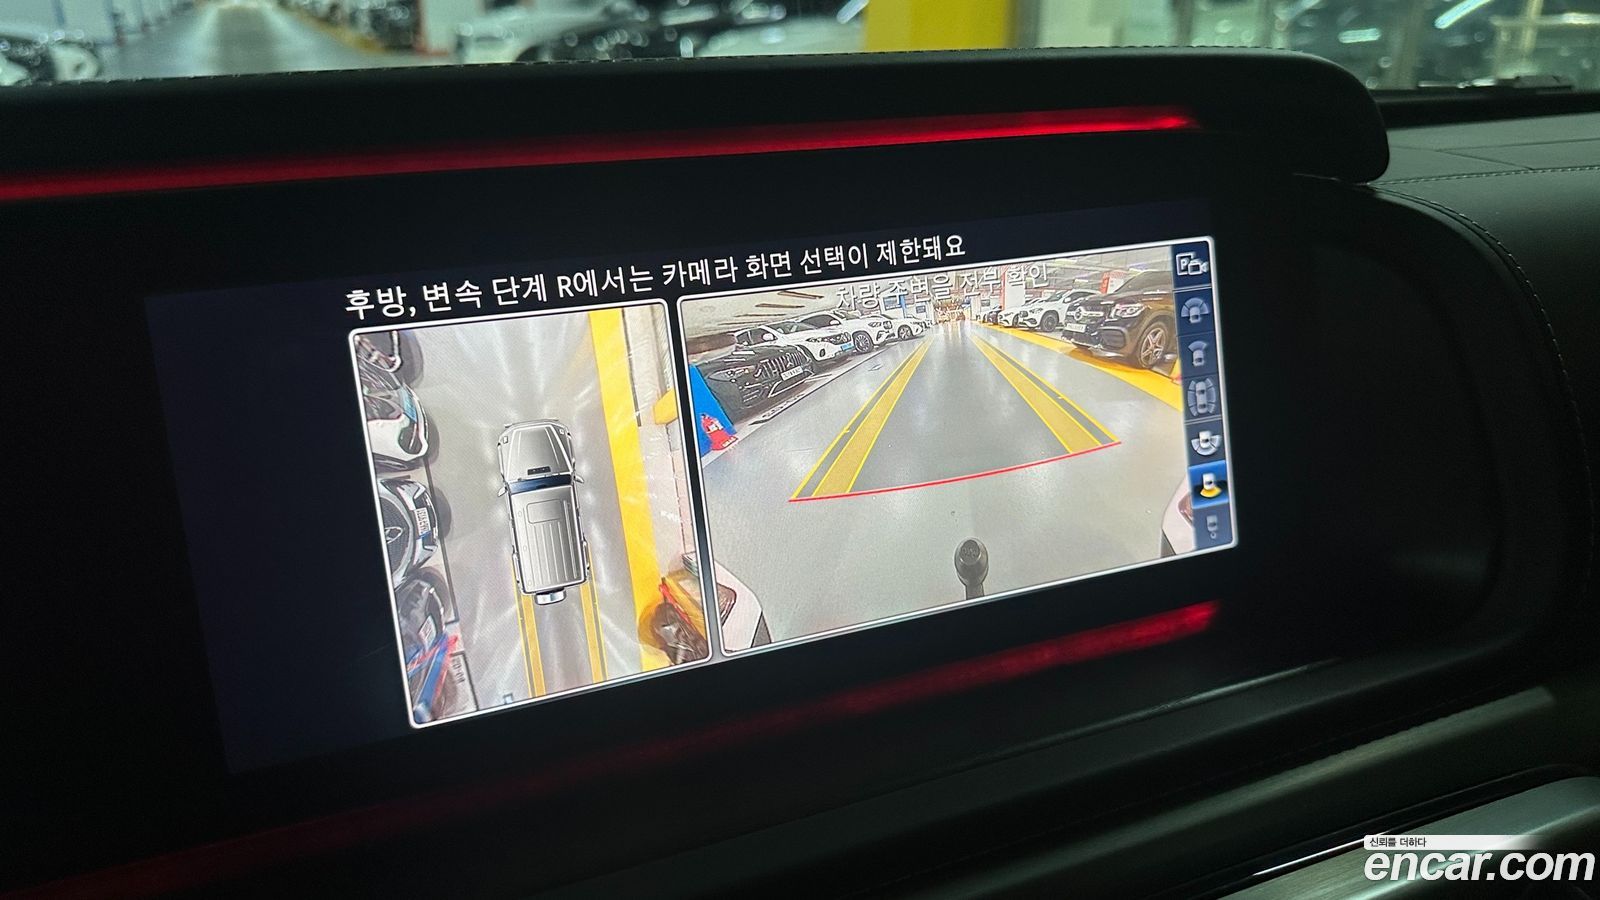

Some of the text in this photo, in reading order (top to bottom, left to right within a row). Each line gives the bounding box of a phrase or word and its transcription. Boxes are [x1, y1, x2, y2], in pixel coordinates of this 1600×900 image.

[345, 235, 966, 319] 후방, 변속 단계 R에서는 카메라 화면 선택이 제한돼요
[836, 282, 880, 311] 차량
[888, 273, 954, 302] 주변을
[1007, 262, 1050, 290] 확인
